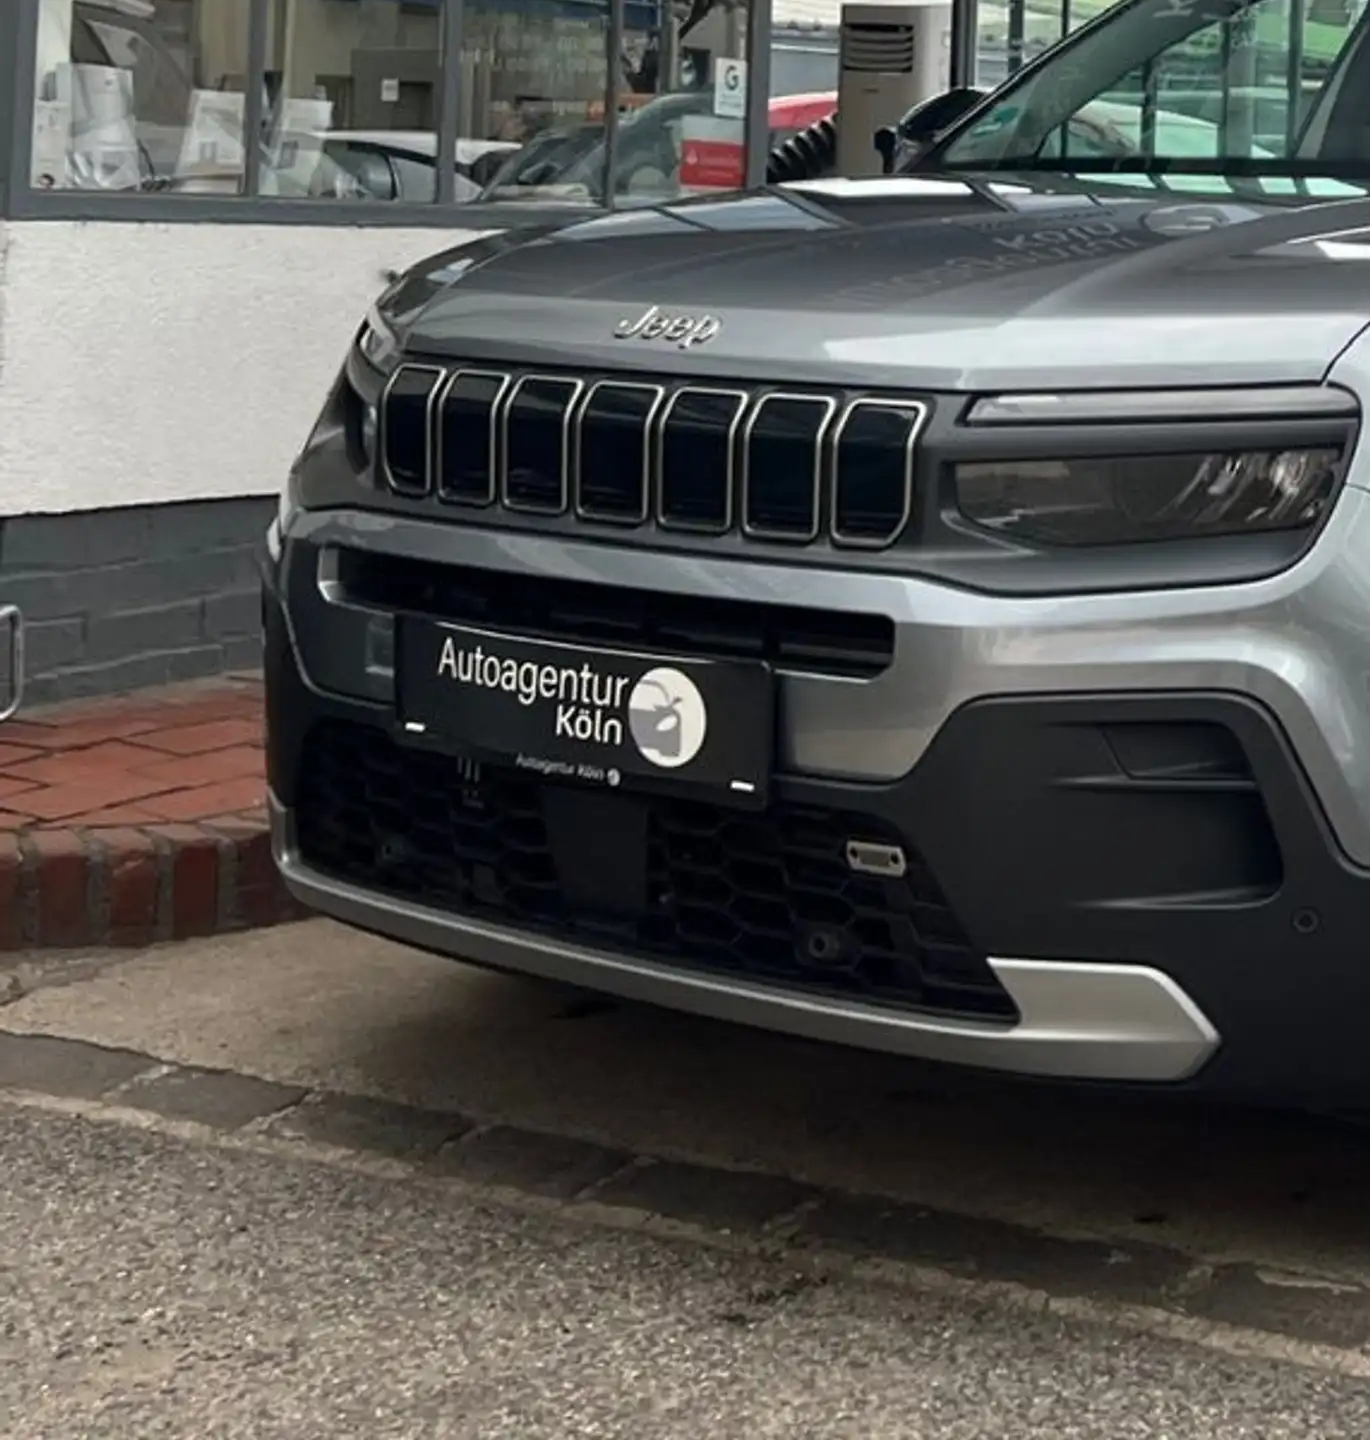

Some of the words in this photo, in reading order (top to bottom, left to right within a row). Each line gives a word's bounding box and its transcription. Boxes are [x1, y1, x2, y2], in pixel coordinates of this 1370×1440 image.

[613, 305, 721, 349] Jeep
[438, 636, 629, 708] Autoagentur
[556, 704, 622, 746] Köln
